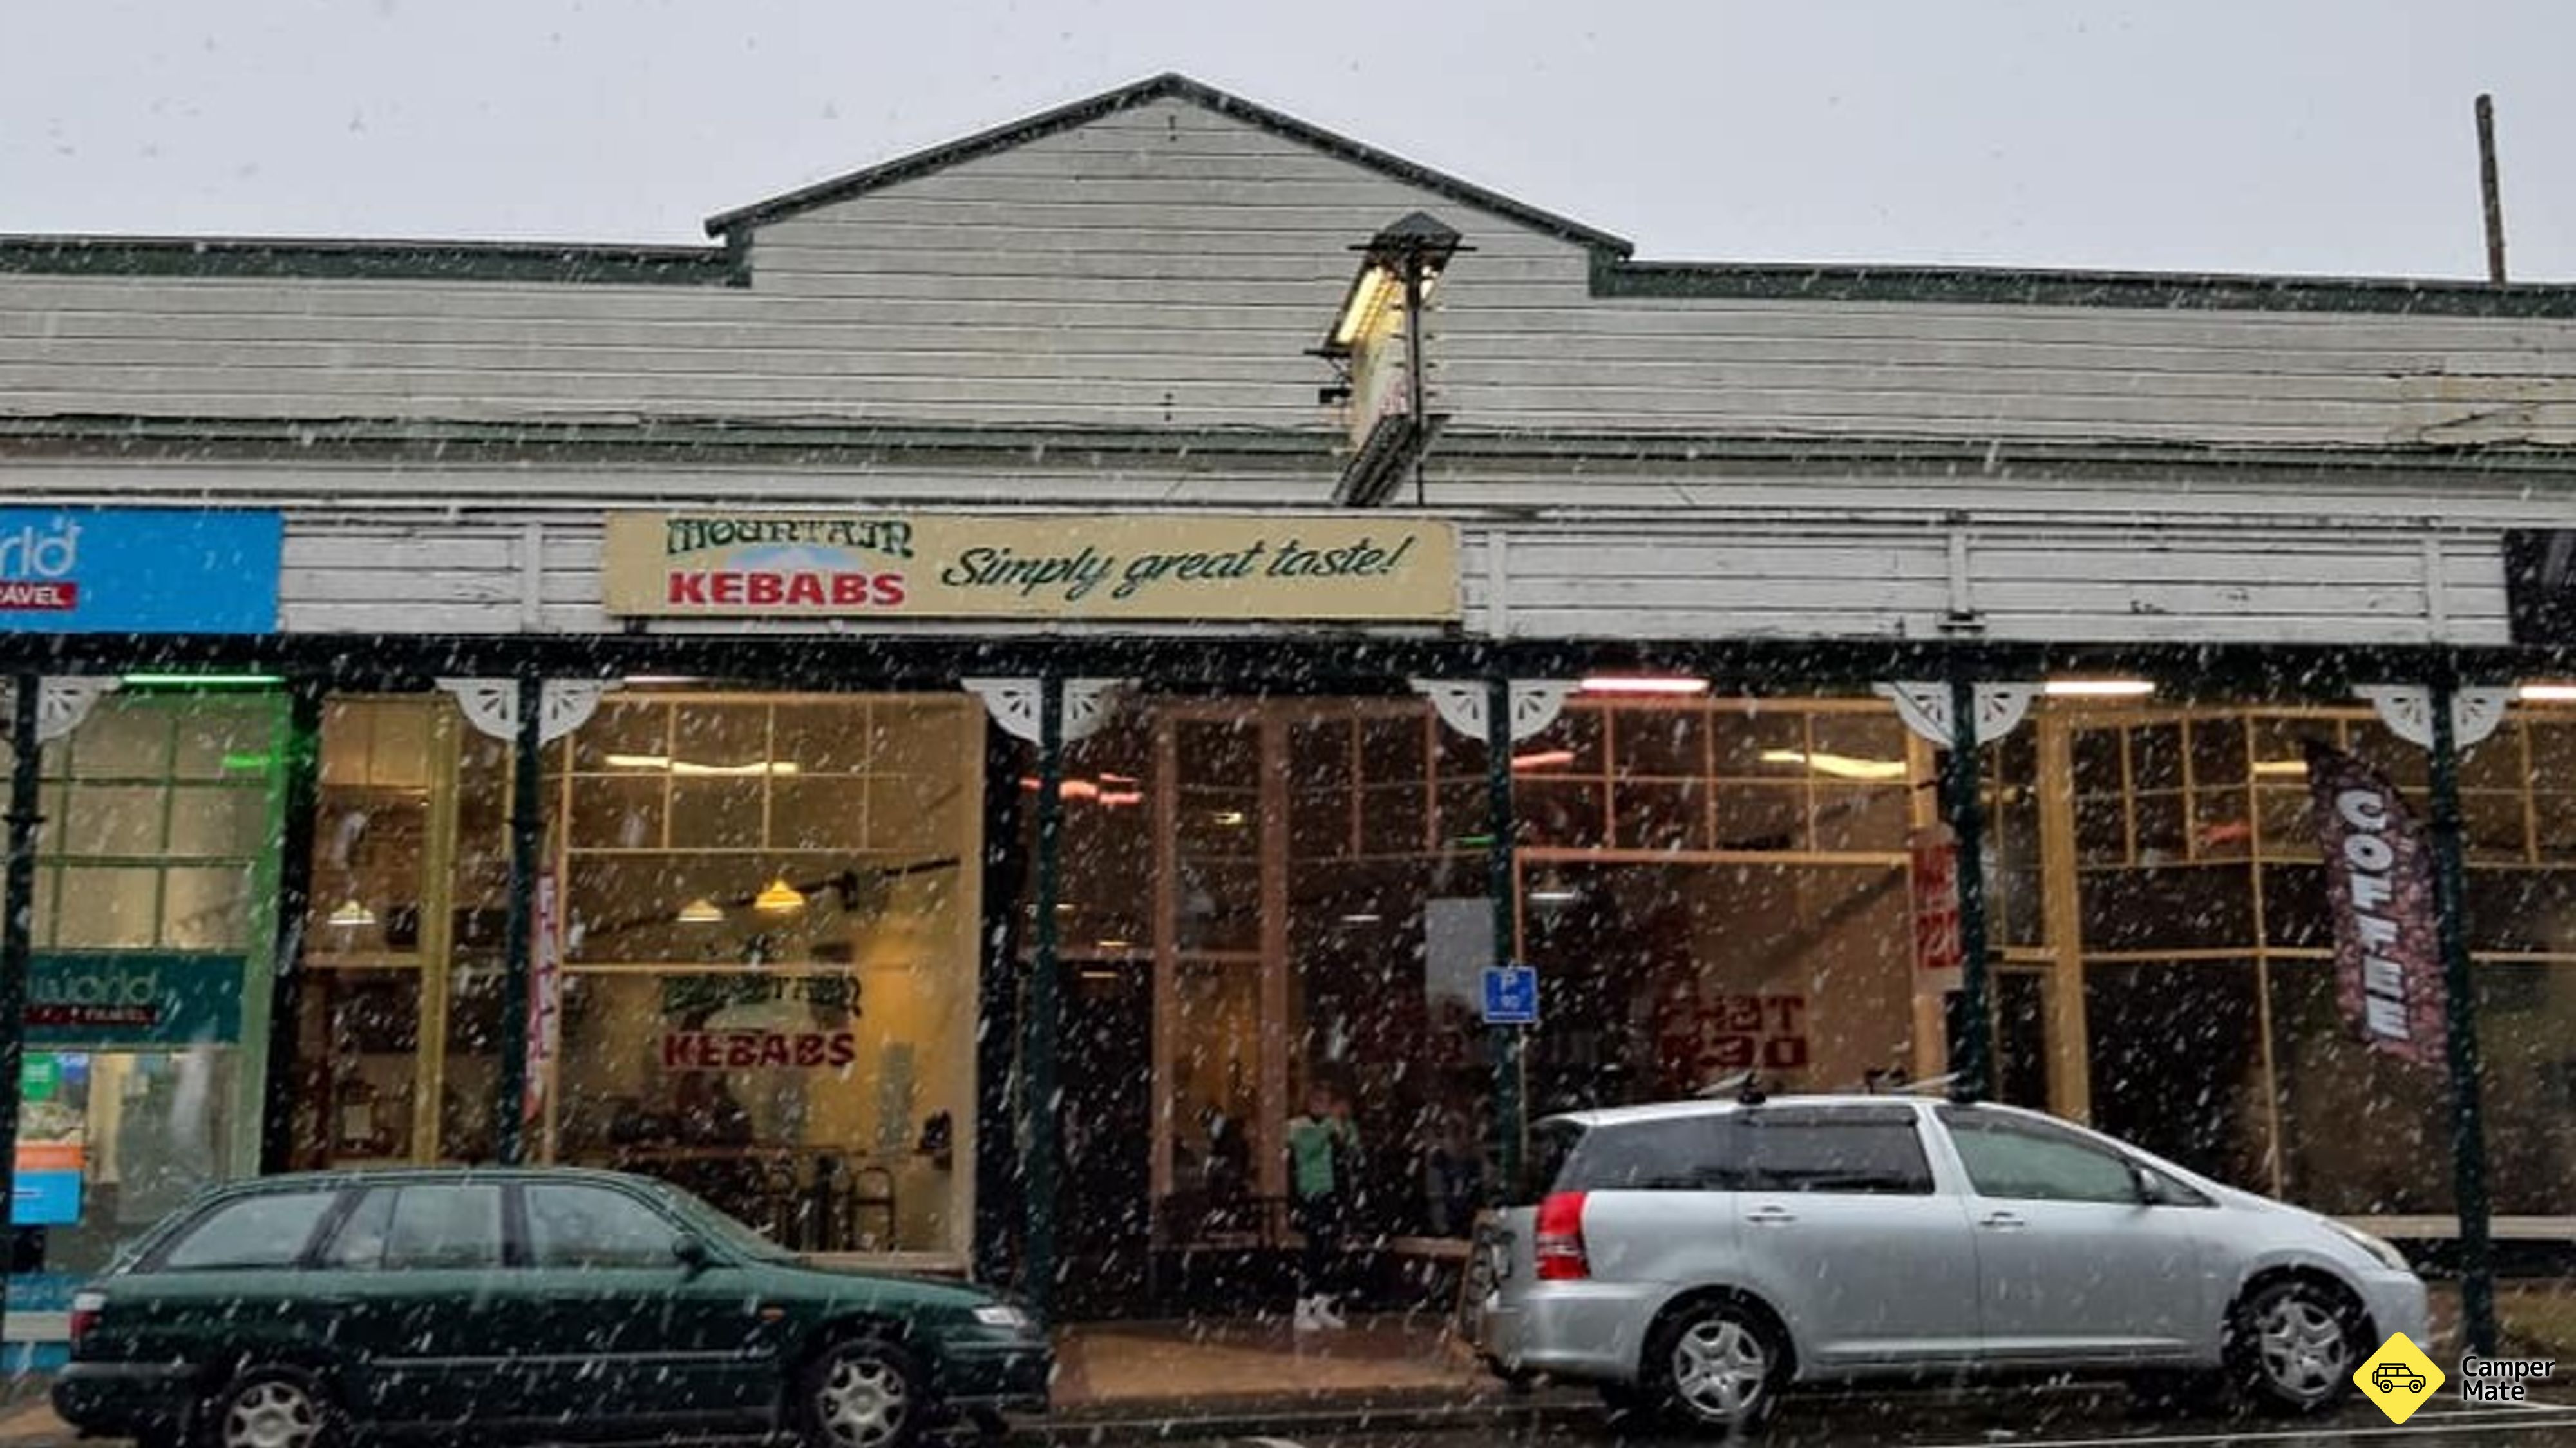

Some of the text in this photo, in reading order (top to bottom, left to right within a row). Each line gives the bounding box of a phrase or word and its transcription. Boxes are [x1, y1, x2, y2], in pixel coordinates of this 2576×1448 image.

[668, 571, 906, 606] KEBABS
[942, 535, 1416, 600] Simply great taste!
[2336, 788, 2410, 1039] COFFEE
[664, 1032, 856, 1067] KEBABS
